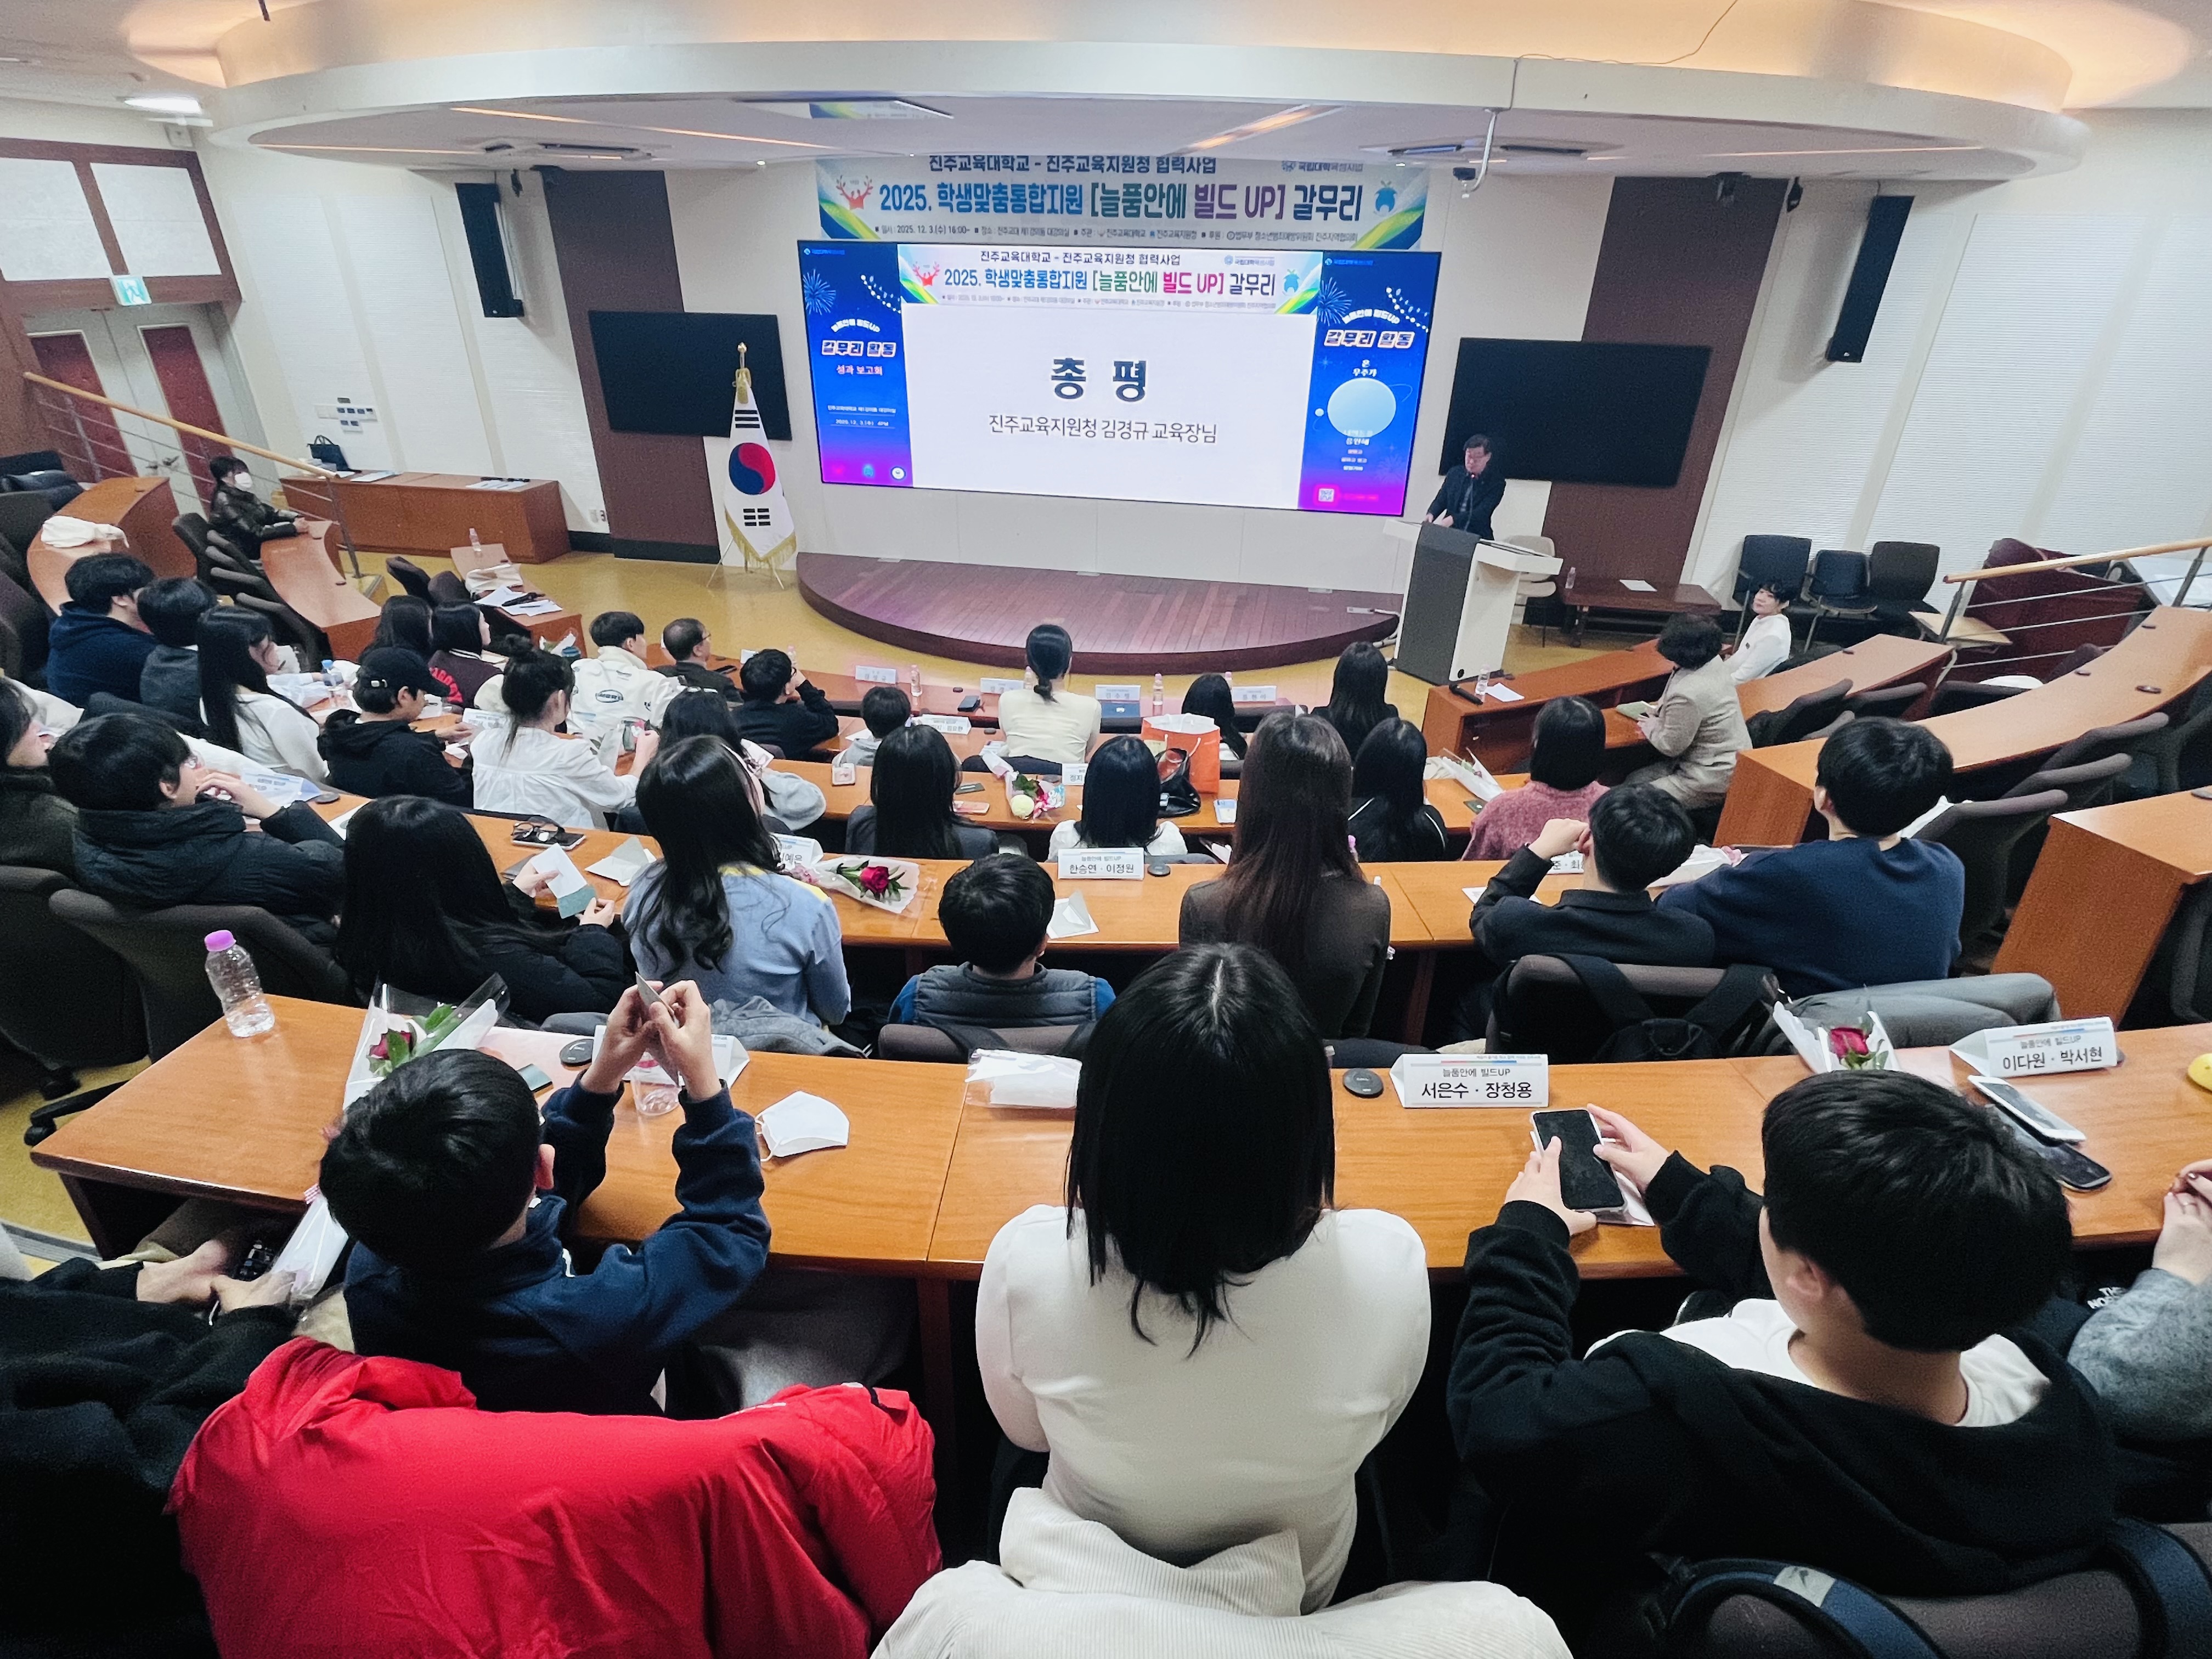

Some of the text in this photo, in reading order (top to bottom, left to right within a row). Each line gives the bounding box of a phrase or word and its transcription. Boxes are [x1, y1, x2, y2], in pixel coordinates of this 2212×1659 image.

[930, 155, 1029, 172] 진주교육대학교
[1047, 156, 1150, 173] 진주교육지원청
[1156, 156, 1216, 174] 협력사업
[880, 182, 1363, 222] 2025. 학생맞춤통합지원 [늘품안에 빌드 UP] 갈무리
[980, 251, 1051, 263] 진주교육대학교
[1063, 253, 1135, 264] 진주교육지원청
[1139, 254, 1181, 266] 협력사업
[944, 268, 1276, 296] 2025. 학생맞춤통합지원 [늘품안에 빌드 UP] 갈무리
[1324, 329, 1377, 347] 갈무리
[821, 340, 864, 357] 갈무리
[1051, 358, 1147, 402] 총 평
[989, 414, 1217, 444] 진주교육지원청 김경규 교육장님
[781, 853, 803, 865] 예은
[1571, 860, 1581, 870] 최
[1106, 864, 1135, 874] 이정원
[2002, 1052, 2046, 1071] 이다원
[2060, 1046, 2103, 1065] 박서현
[1443, 1068, 1511, 1078] 늘품안에 빌드UP
[1421, 1082, 1469, 1099] 서은수
[1485, 1082, 1532, 1099] 장청용
